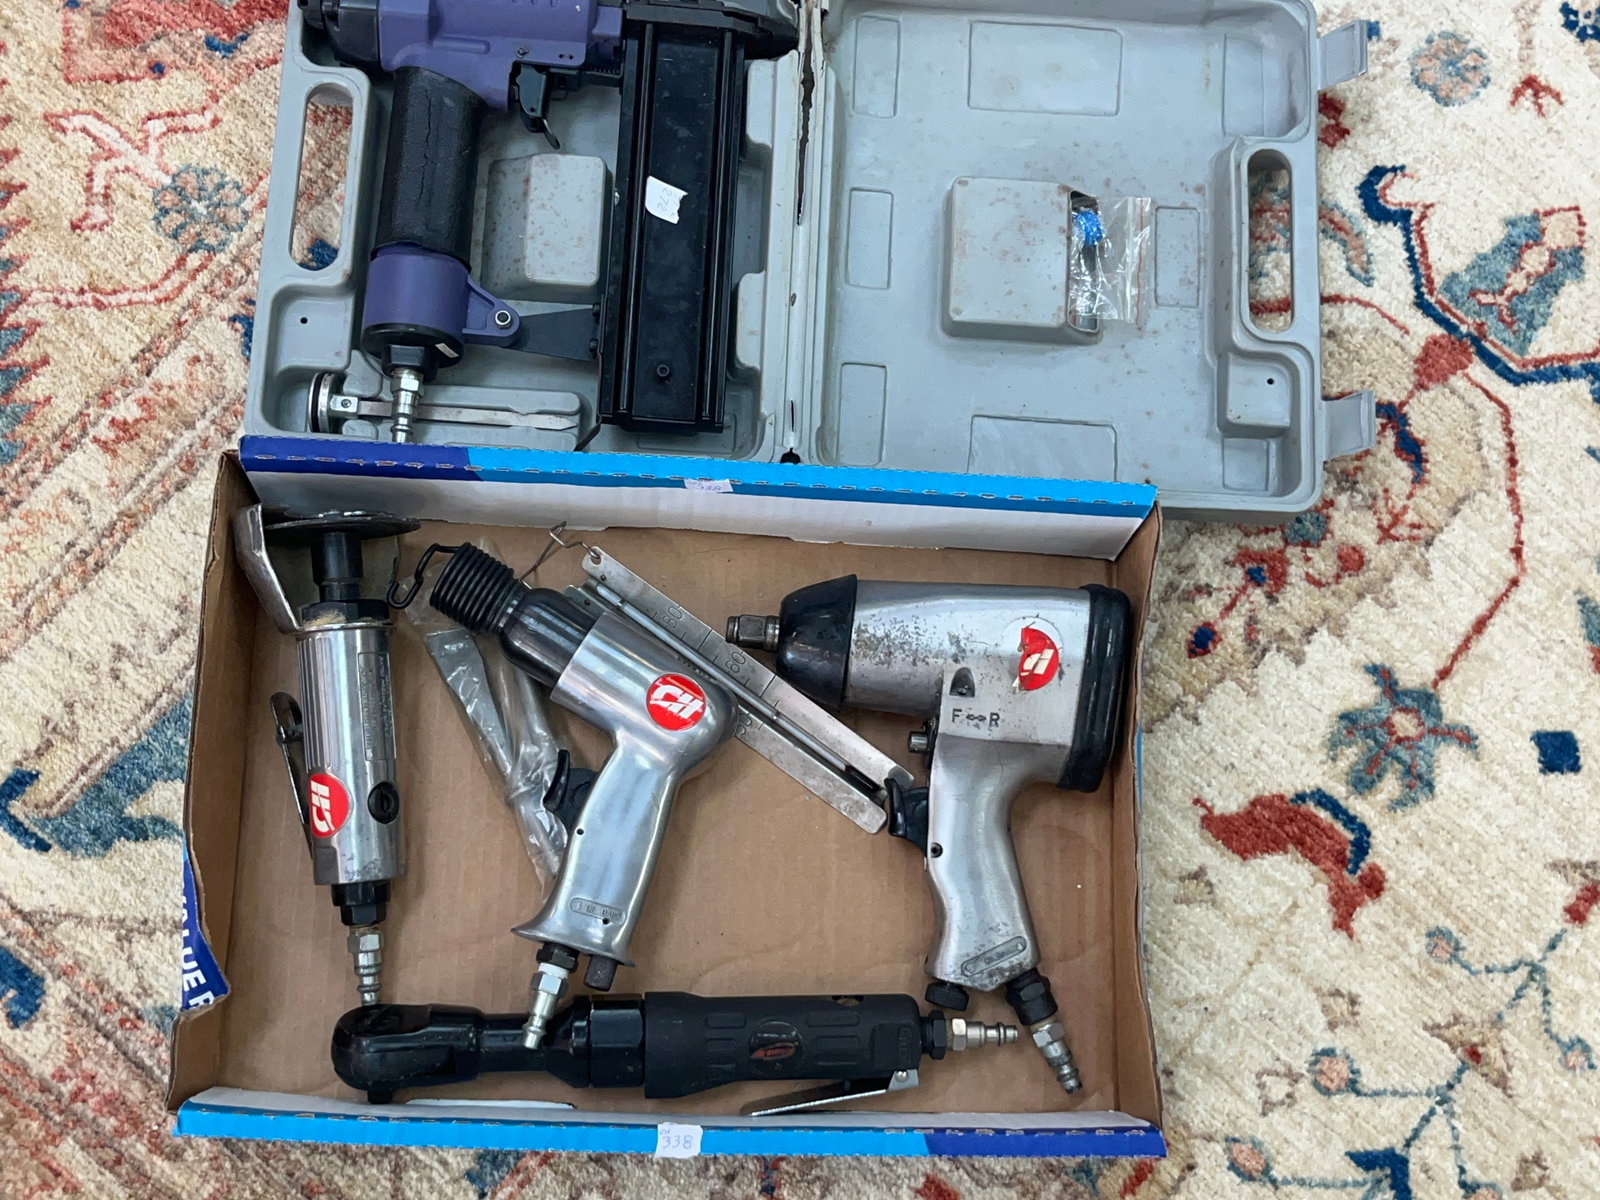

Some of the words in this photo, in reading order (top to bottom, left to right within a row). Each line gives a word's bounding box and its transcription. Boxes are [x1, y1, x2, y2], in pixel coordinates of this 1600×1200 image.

[663, 606, 683, 629] 80
[725, 651, 746, 673] 60
[951, 708, 963, 722] F
[988, 712, 1001, 728] R
[662, 1134, 694, 1150] 338
